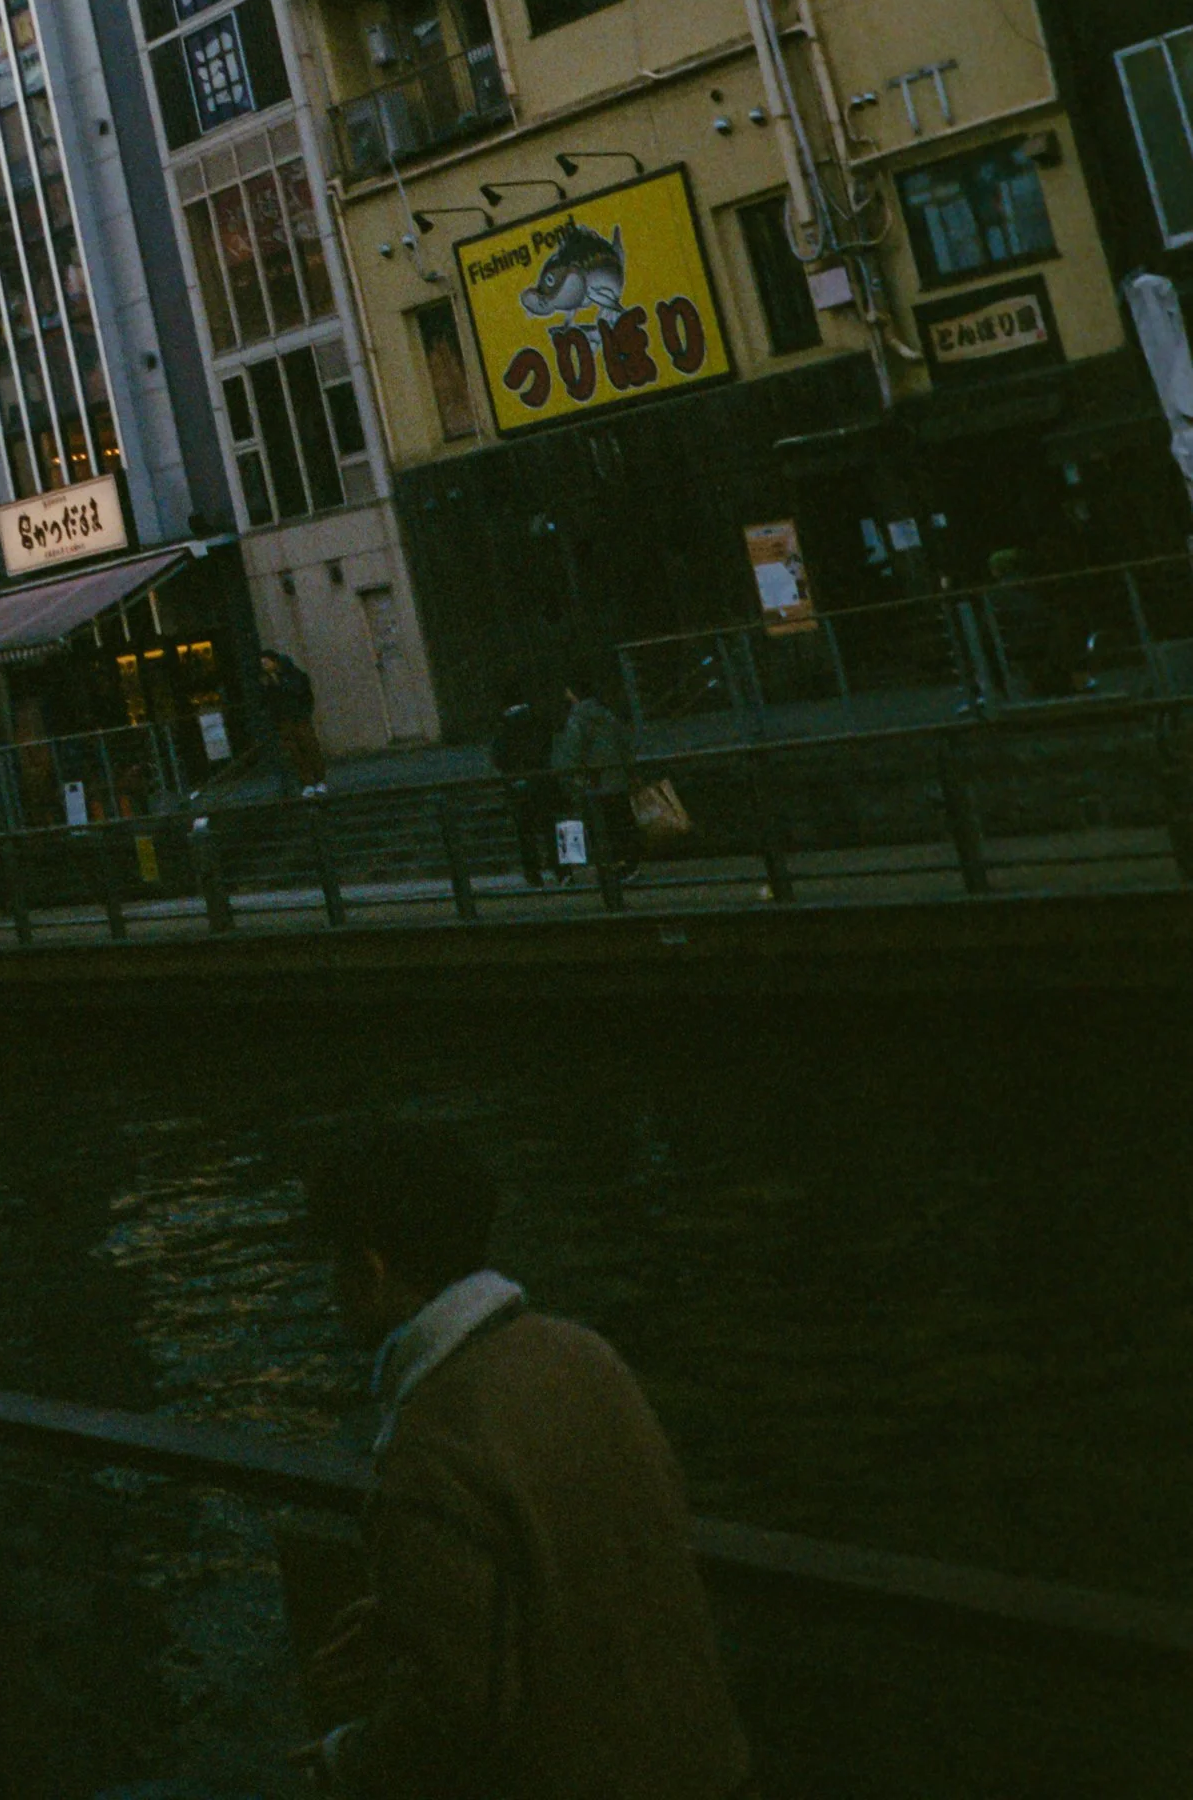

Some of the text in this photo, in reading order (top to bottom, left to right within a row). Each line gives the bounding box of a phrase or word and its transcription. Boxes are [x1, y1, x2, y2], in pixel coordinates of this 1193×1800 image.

[468, 245, 532, 285] Fishing
[504, 296, 705, 408] つりぼり
